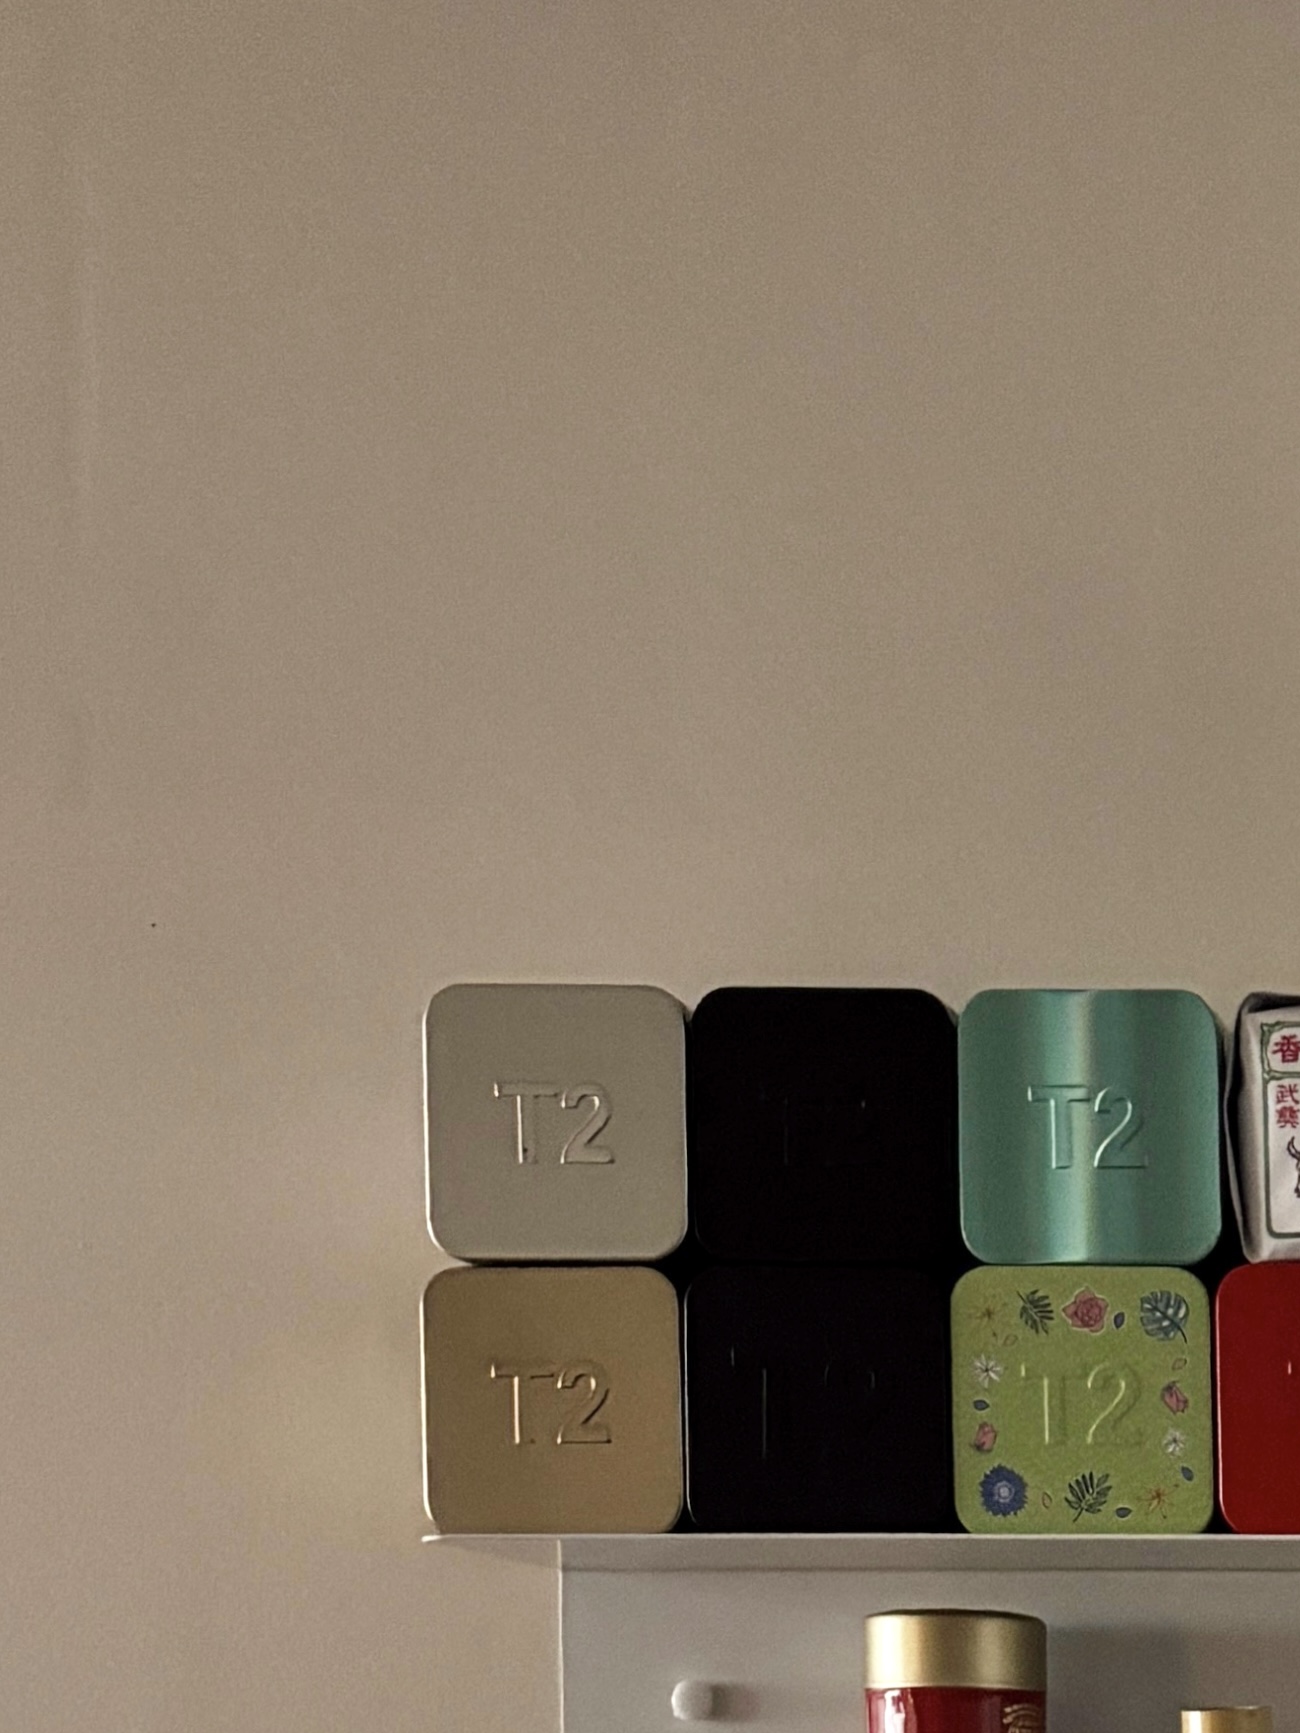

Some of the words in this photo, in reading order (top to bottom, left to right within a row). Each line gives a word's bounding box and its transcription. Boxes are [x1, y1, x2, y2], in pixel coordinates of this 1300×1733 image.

[492, 1079, 615, 1164] T2
[1027, 1084, 1149, 1170] T2
[490, 1359, 612, 1445] T2
[1020, 1361, 1144, 1445] T2
